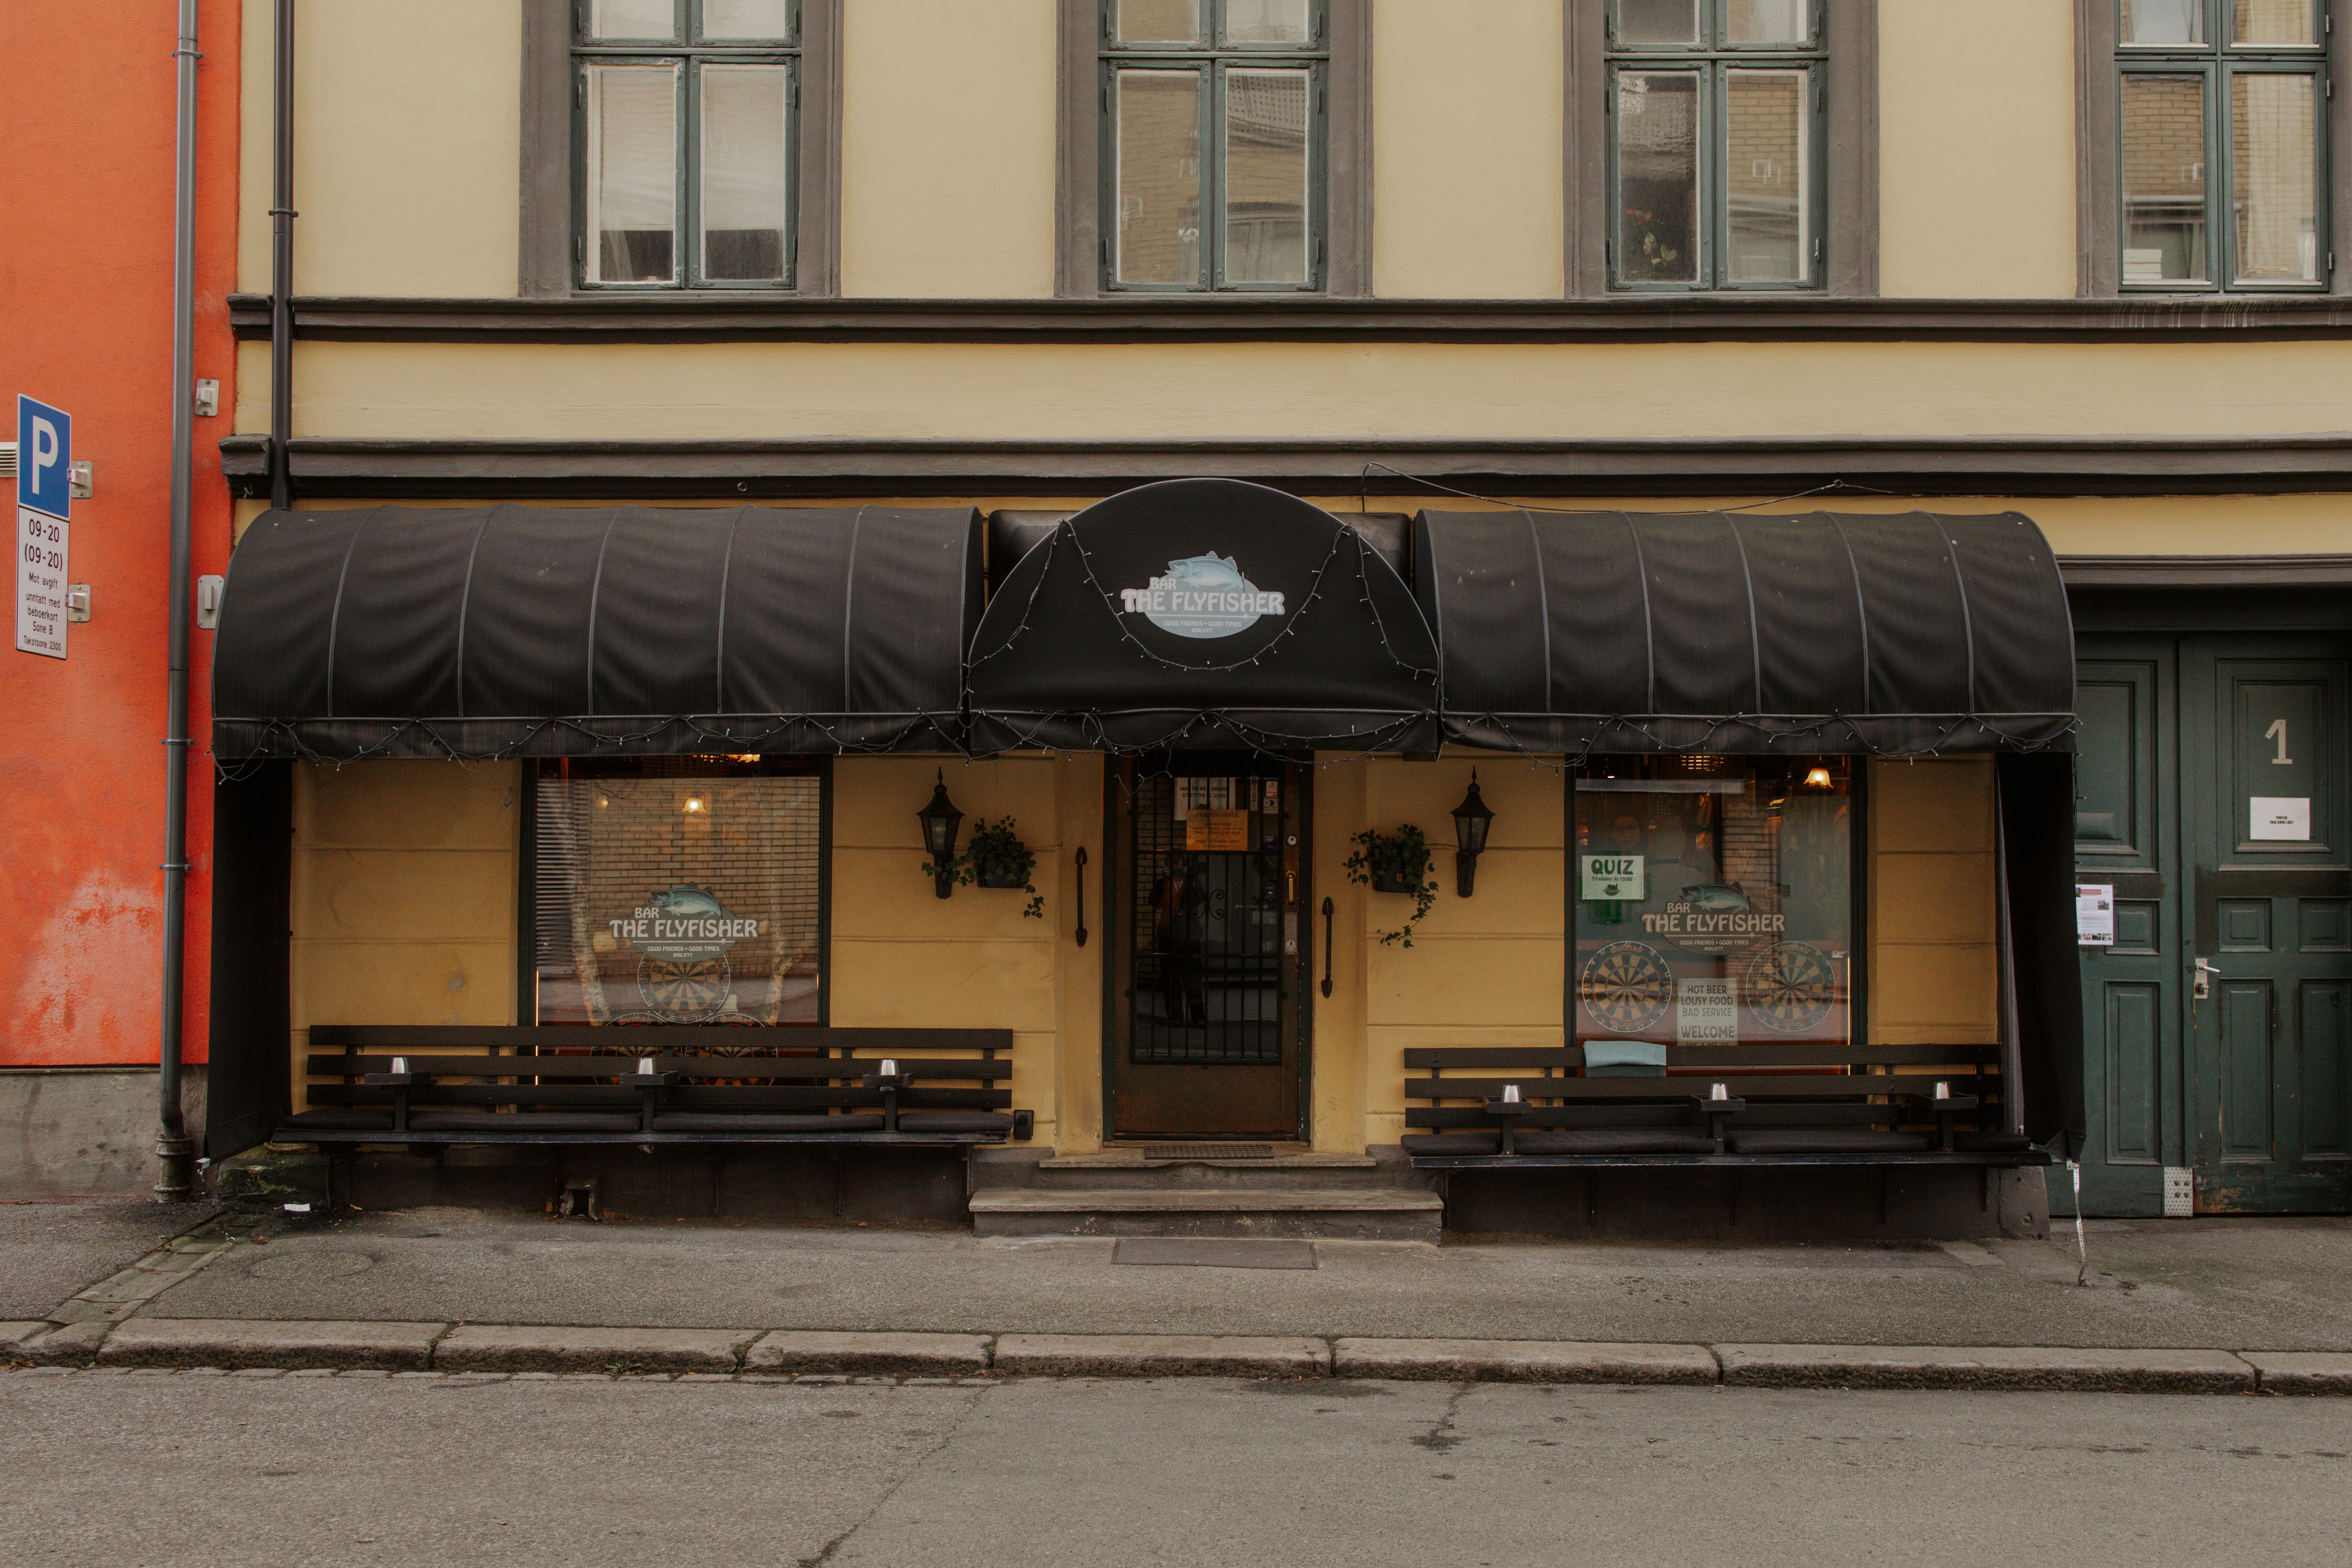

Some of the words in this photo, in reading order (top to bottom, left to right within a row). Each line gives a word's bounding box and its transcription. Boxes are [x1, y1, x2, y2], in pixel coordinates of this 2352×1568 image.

[32, 415, 58, 495] P
[29, 519, 59, 543] 09-20
[25, 543, 63, 572] (09-20)
[29, 572, 40, 583] Mot
[42, 572, 58, 589] avgift
[1151, 578, 1177, 590] BAR
[26, 592, 46, 606] unntatt
[49, 595, 60, 608] med
[1122, 591, 1165, 611] THE
[1172, 592, 1283, 612] FLYFISHER
[28, 607, 58, 622] beboerkort
[33, 621, 47, 633] Sone
[49, 625, 53, 635] B
[24, 636, 48, 649] Takstsone
[50, 640, 61, 652] 2300
[2265, 719, 2293, 764] 1
[1591, 859, 1634, 874] QUIZ
[635, 908, 659, 919] BAR
[1667, 902, 1690, 913] BAR
[610, 919, 649, 937] THE
[655, 919, 758, 938] FLYFISHER
[1642, 914, 1680, 931] THE
[1687, 914, 1785, 931] FLYFISHER
[1687, 985, 1704, 994] HOT
[1707, 985, 1726, 994] BEER
[1681, 997, 1707, 1005] LOUSY
[1710, 997, 1733, 1005] FOOD
[1683, 1008, 1699, 1016] BAD
[1702, 1008, 1732, 1016] SERVICE
[1681, 1026, 1735, 1038] WELCOME
